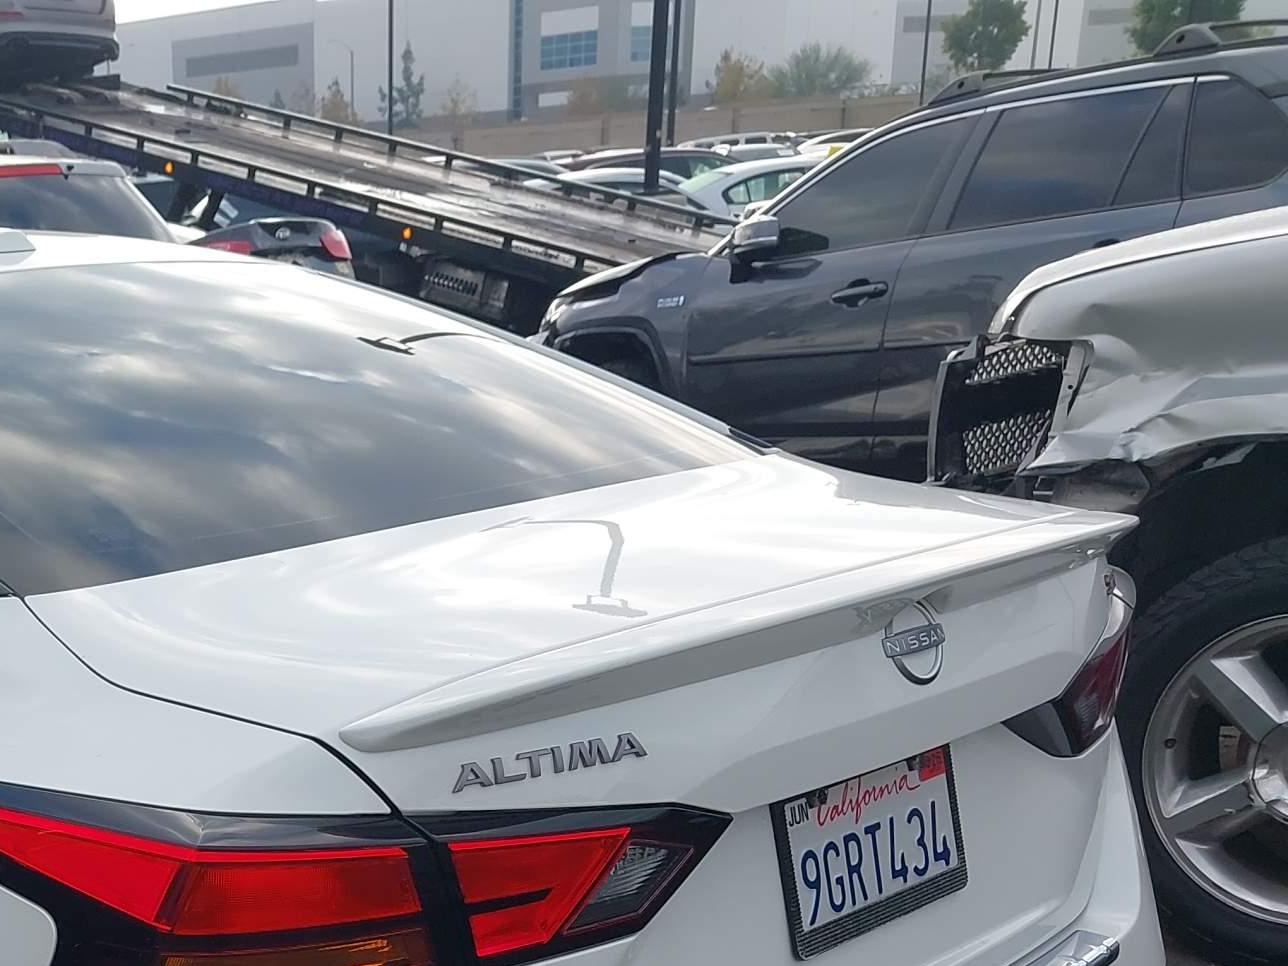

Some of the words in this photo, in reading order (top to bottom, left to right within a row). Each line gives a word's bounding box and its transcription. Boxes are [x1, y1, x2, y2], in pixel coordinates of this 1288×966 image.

[451, 732, 649, 794] ALTIMA
[788, 805, 811, 828] JUN
[816, 768, 921, 827] California
[800, 799, 952, 927] 9GRT434
